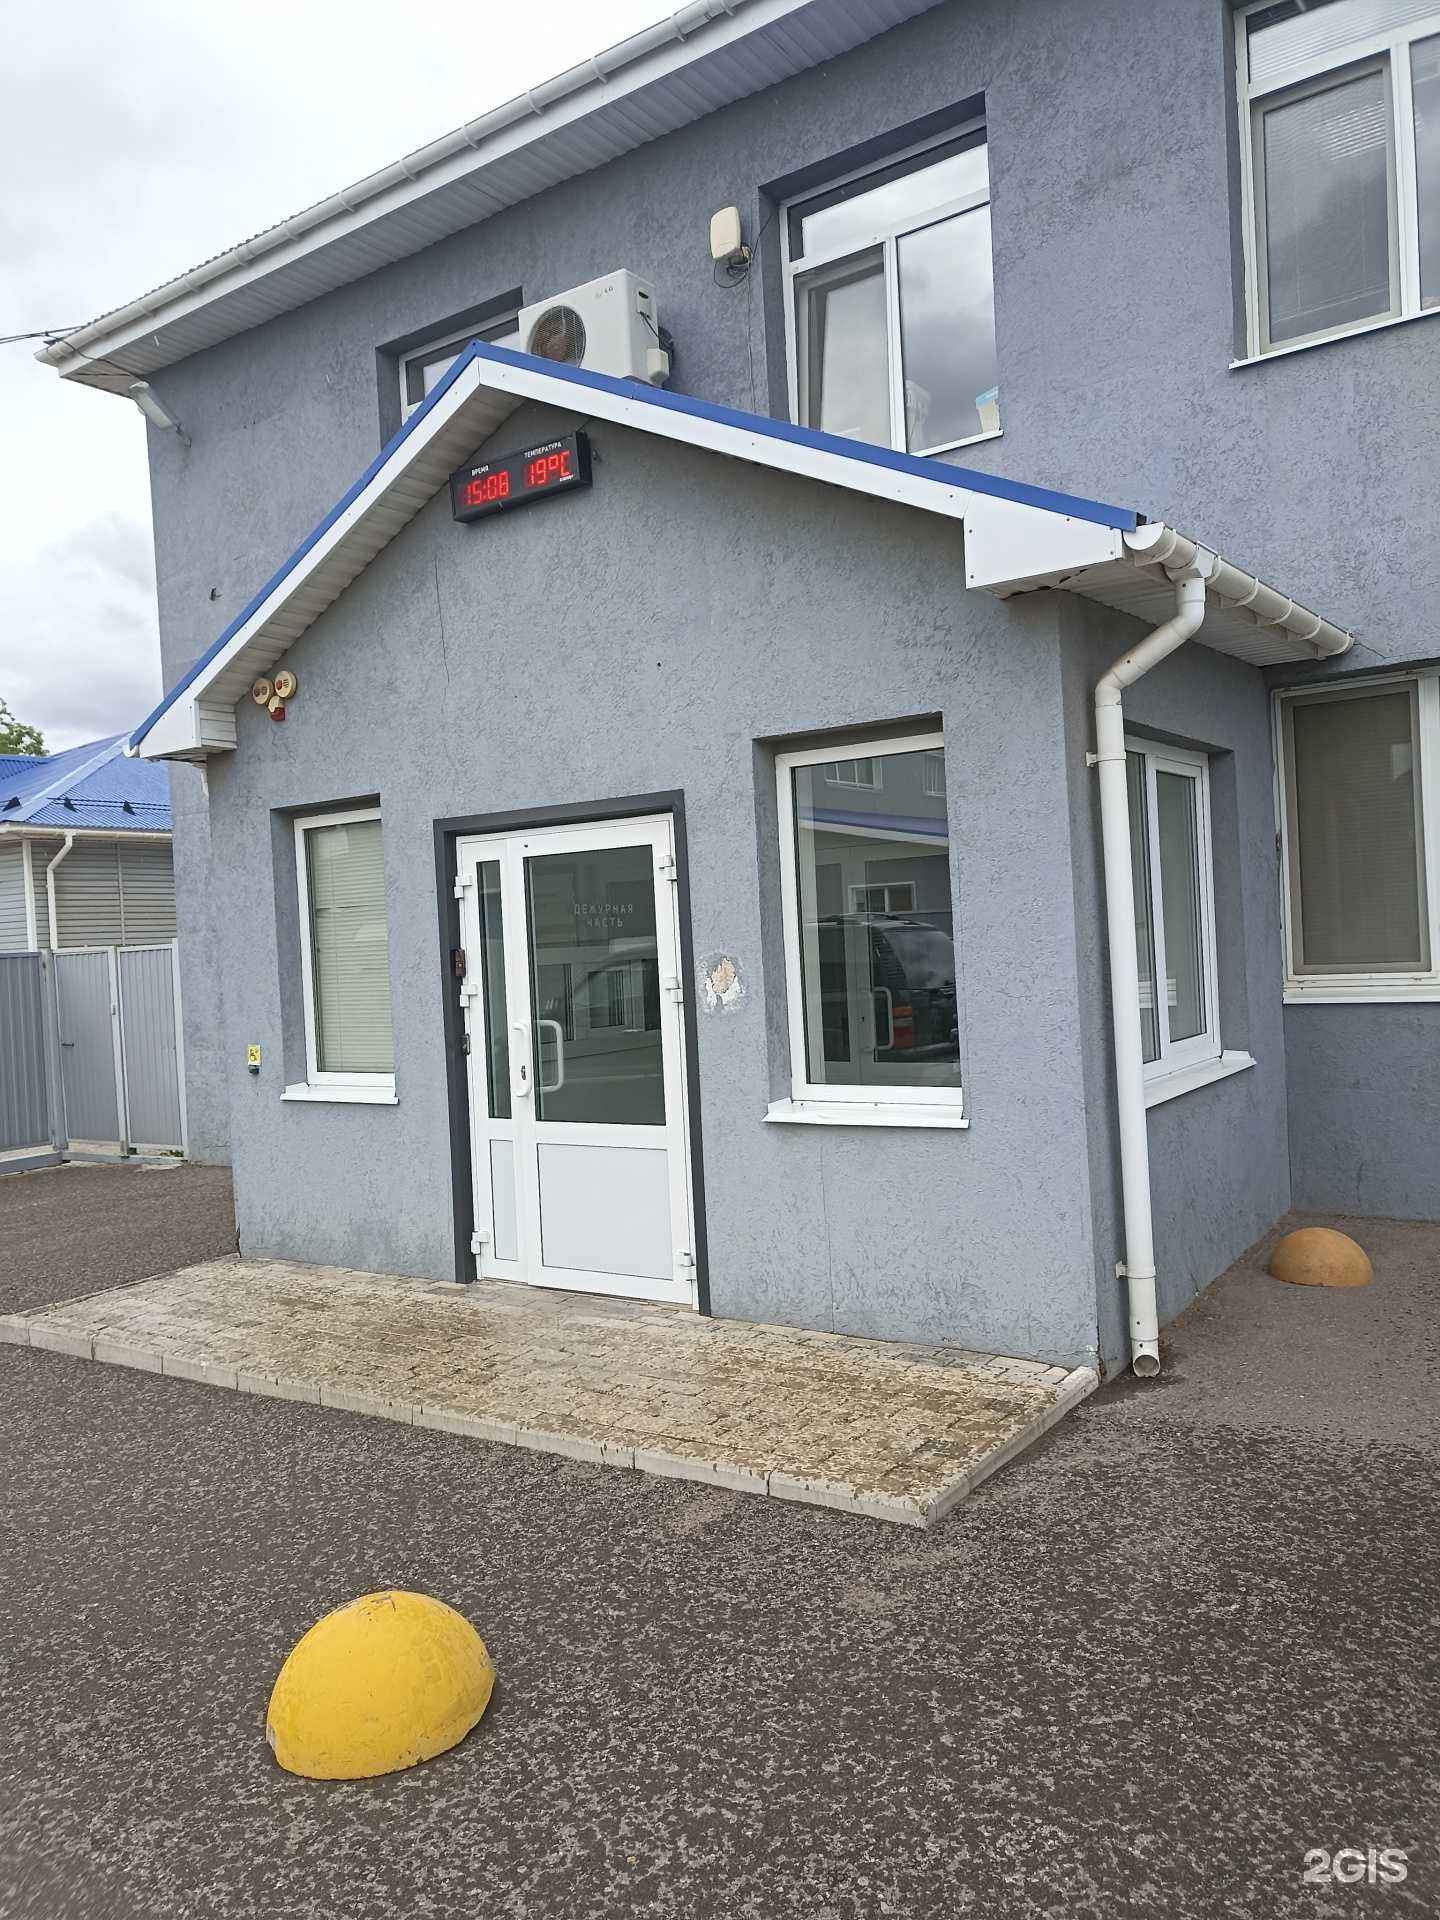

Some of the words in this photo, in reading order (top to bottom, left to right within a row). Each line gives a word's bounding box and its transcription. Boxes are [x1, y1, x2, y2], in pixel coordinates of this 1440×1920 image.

[524, 441, 562, 459] ТЕМПЕРАТУРА
[471, 465, 489, 477] ВРЕМЯ
[574, 903, 633, 915] ДЕЖУРНАЯ
[587, 917, 624, 929] ЧАСТЬ
